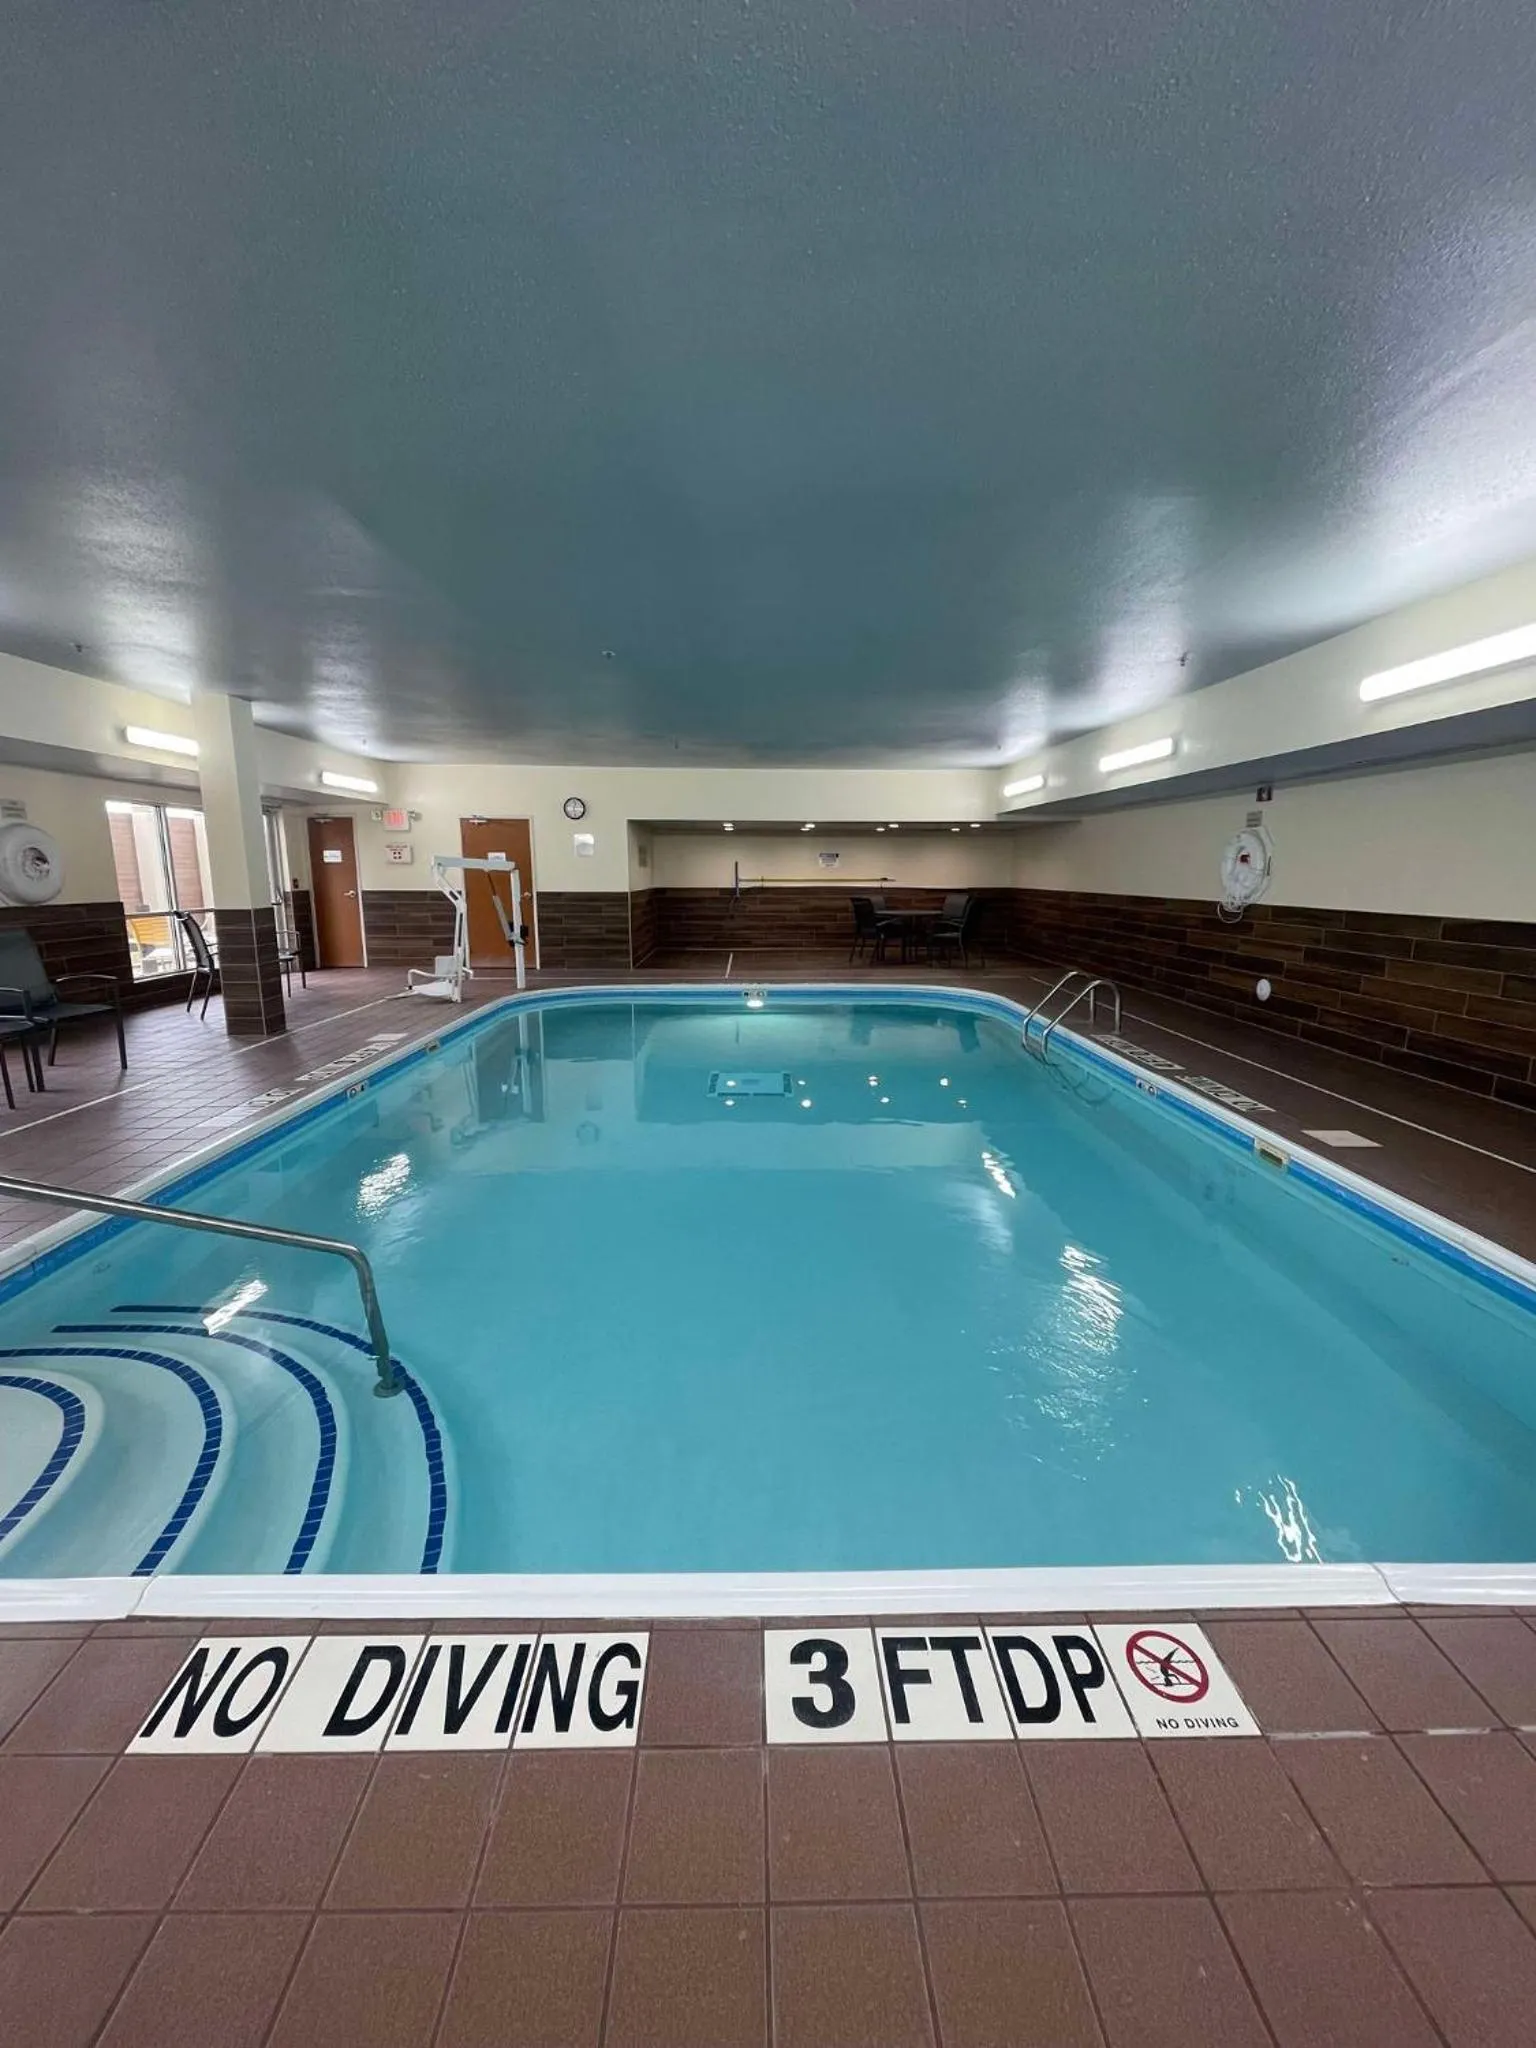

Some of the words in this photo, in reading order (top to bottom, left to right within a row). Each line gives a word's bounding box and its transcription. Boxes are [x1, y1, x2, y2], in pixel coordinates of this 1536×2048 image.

[138, 1646, 290, 1738] NO
[321, 1641, 643, 1737] DIVING
[789, 1638, 857, 1730] 3
[1155, 1718, 1179, 1730] NO
[1183, 1716, 1239, 1729] DIVING
